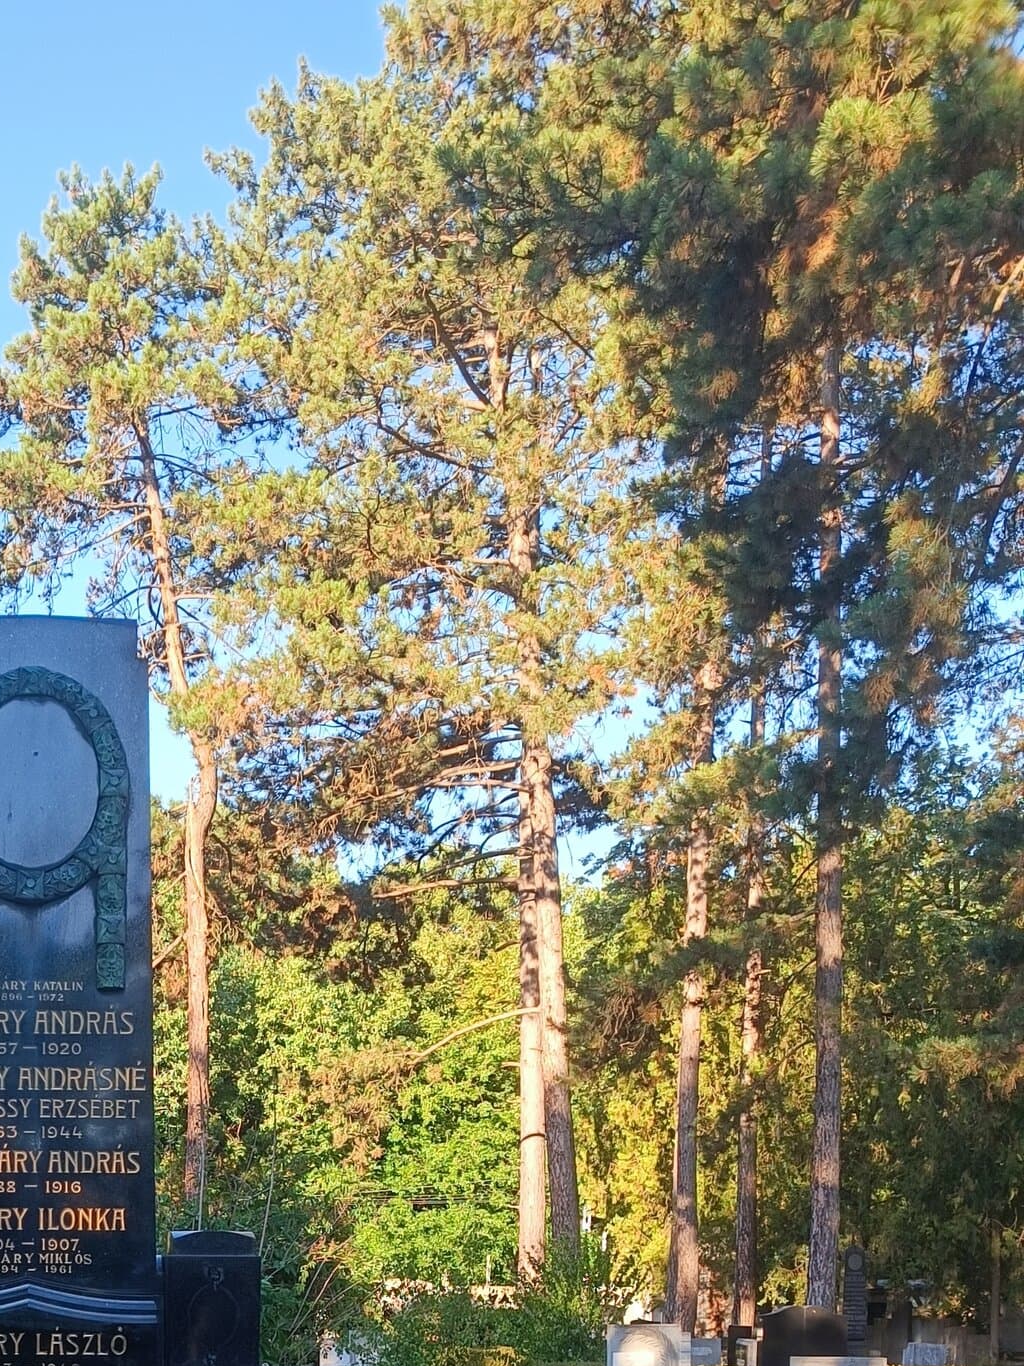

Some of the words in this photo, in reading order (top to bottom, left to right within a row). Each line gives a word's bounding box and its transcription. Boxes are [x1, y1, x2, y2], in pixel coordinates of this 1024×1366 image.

[33, 980, 84, 991] KATALIN
[33, 1004, 134, 1035] ANDRÁS
[42, 1042, 82, 1055] 1920
[18, 1060, 146, 1091] ANDRÁSNÉ
[39, 1095, 140, 1119] ERZSÉBET
[41, 1126, 83, 1139] 1944
[47, 1144, 141, 1174] ANDRÁS
[45, 1181, 82, 1194] 1916
[38, 1207, 127, 1231] ILONKA
[41, 1238, 80, 1251] 1907
[39, 1249, 92, 1264] MIKLÓS
[45, 1264, 73, 1274] 1961
[36, 1326, 127, 1355] LÁSZLÓ
